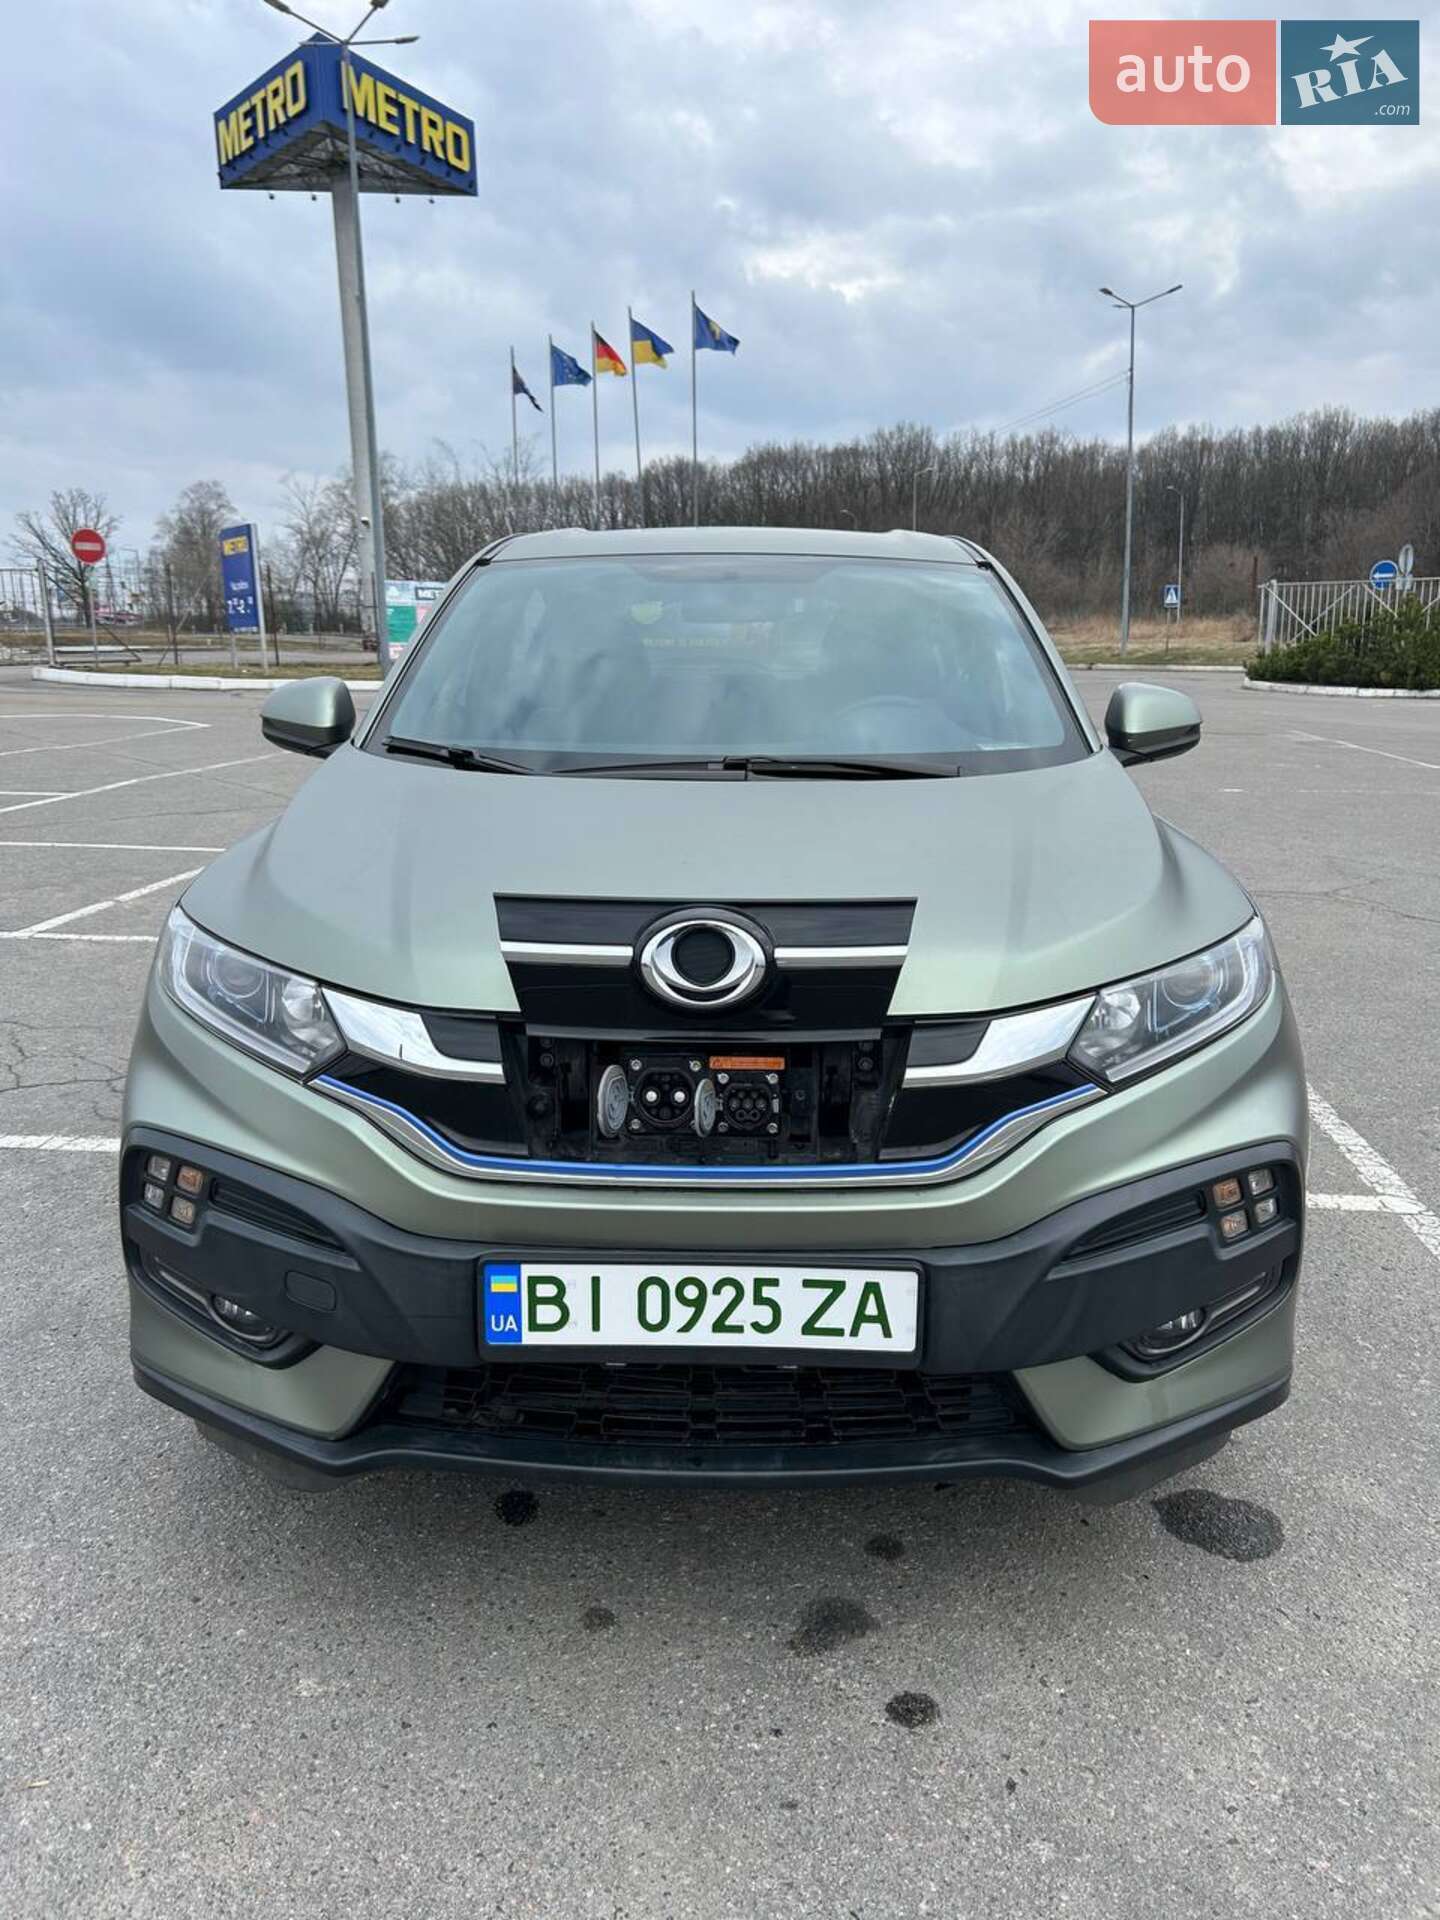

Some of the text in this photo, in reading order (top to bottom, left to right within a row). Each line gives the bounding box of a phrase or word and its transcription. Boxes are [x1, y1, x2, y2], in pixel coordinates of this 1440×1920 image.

[218, 60, 307, 165] METRO
[340, 60, 471, 173] METRO
[491, 1314, 518, 1333] UA
[526, 1276, 893, 1339] BI 0925 ZA
